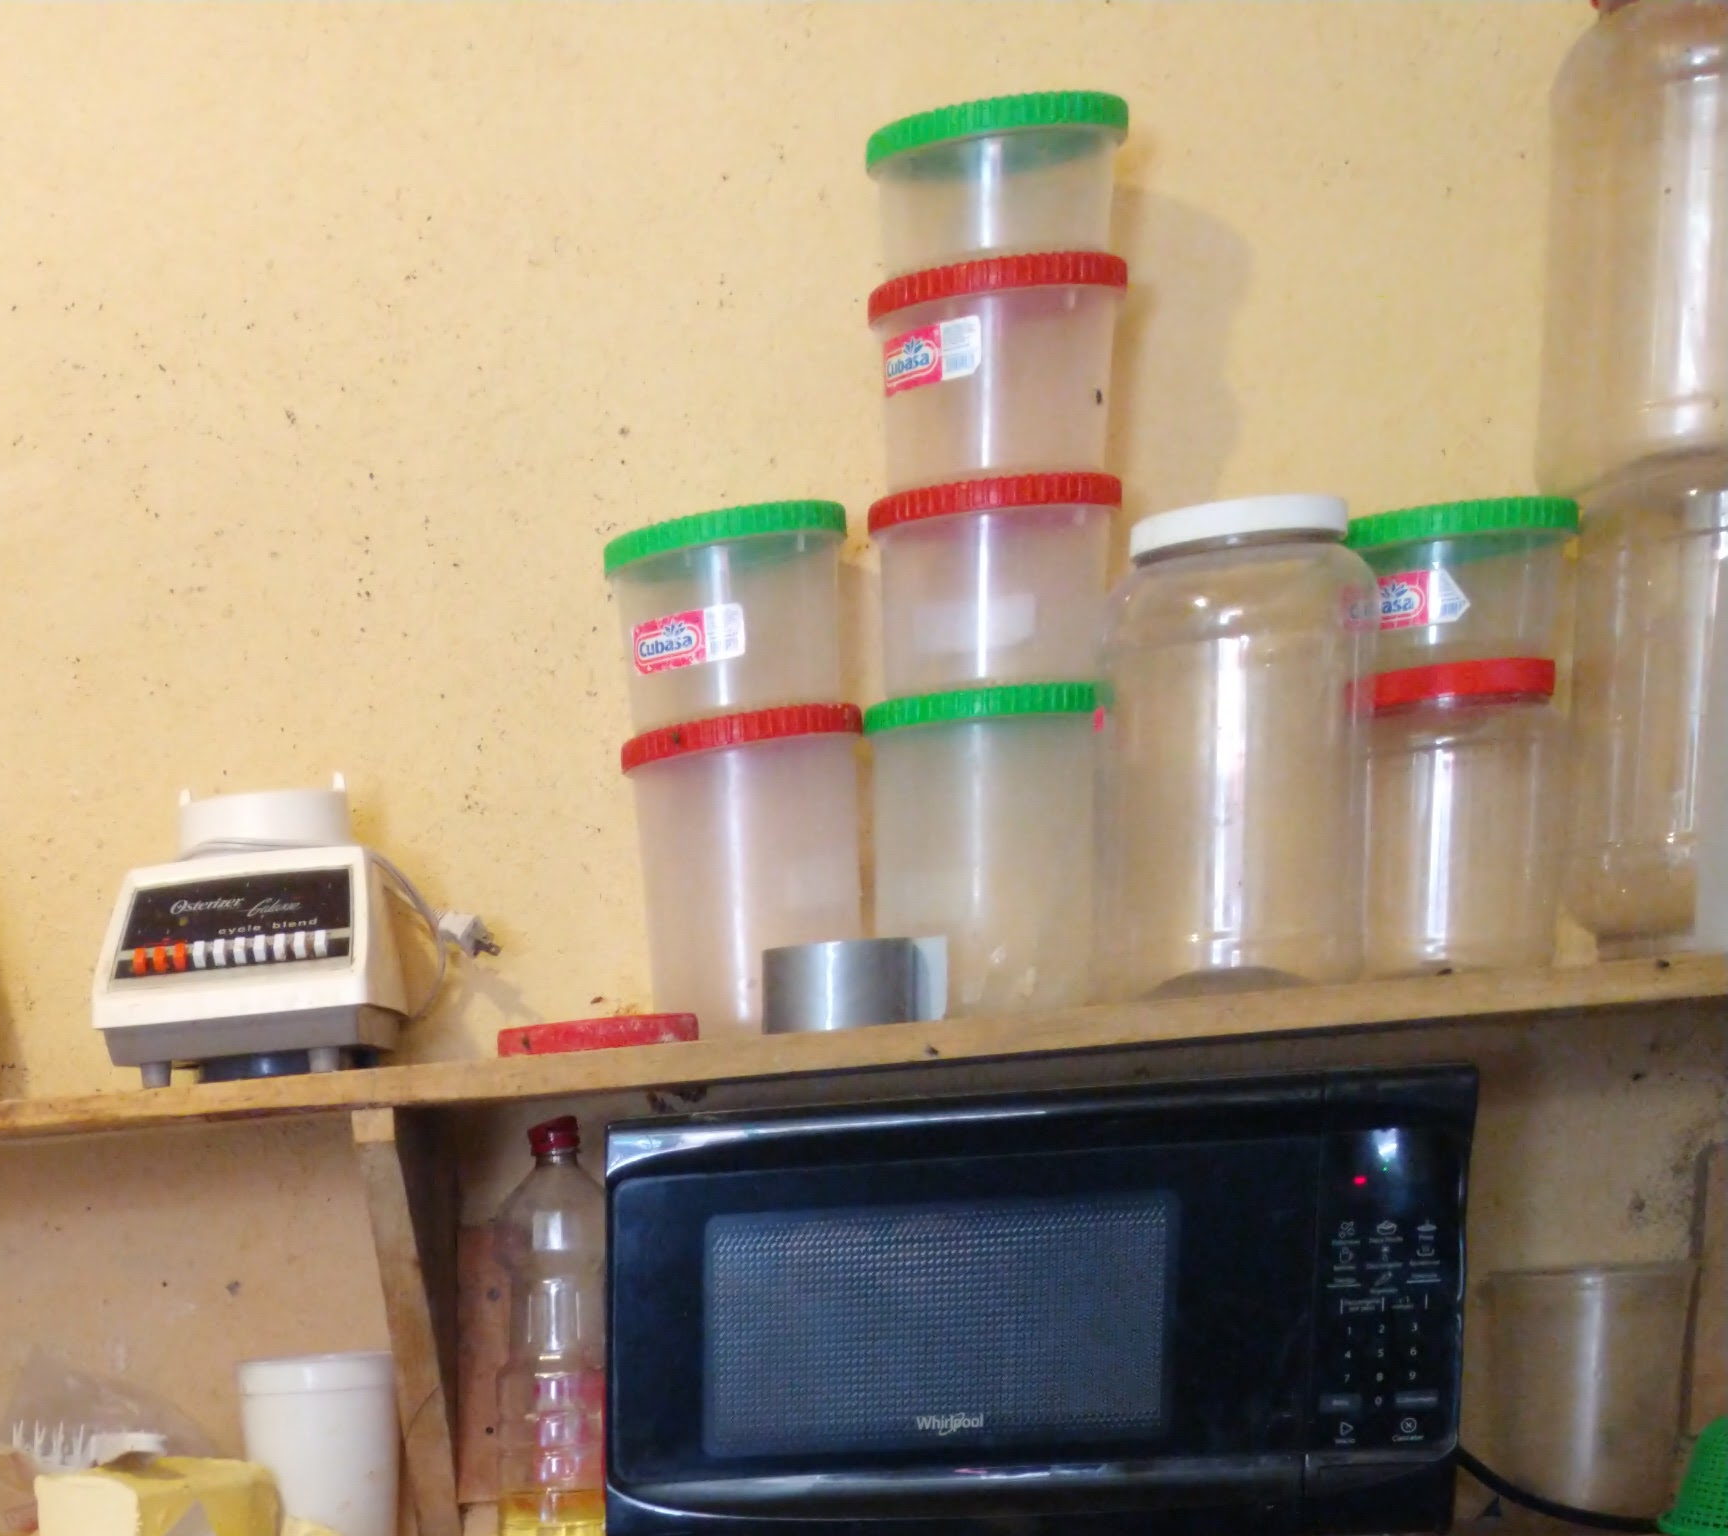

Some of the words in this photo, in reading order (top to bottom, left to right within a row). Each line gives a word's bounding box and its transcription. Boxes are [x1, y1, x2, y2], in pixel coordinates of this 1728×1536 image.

[886, 352, 930, 377] Cubasa
[639, 634, 693, 658] Cubasa
[170, 897, 245, 915] Osterizer
[272, 919, 318, 929] blend
[1346, 1326, 1352, 1335] 1
[1378, 1323, 1386, 1334] 2
[1411, 1321, 1419, 1332] 3
[1344, 1350, 1351, 1360] 4
[1377, 1348, 1385, 1358] 5
[1410, 1346, 1418, 1356] 6
[1344, 1374, 1351, 1384] 7
[1376, 1372, 1384, 1383] 8
[1409, 1370, 1417, 1381] 9
[1375, 1396, 1383, 1407] 0
[916, 1412, 984, 1435] Whirlpool
